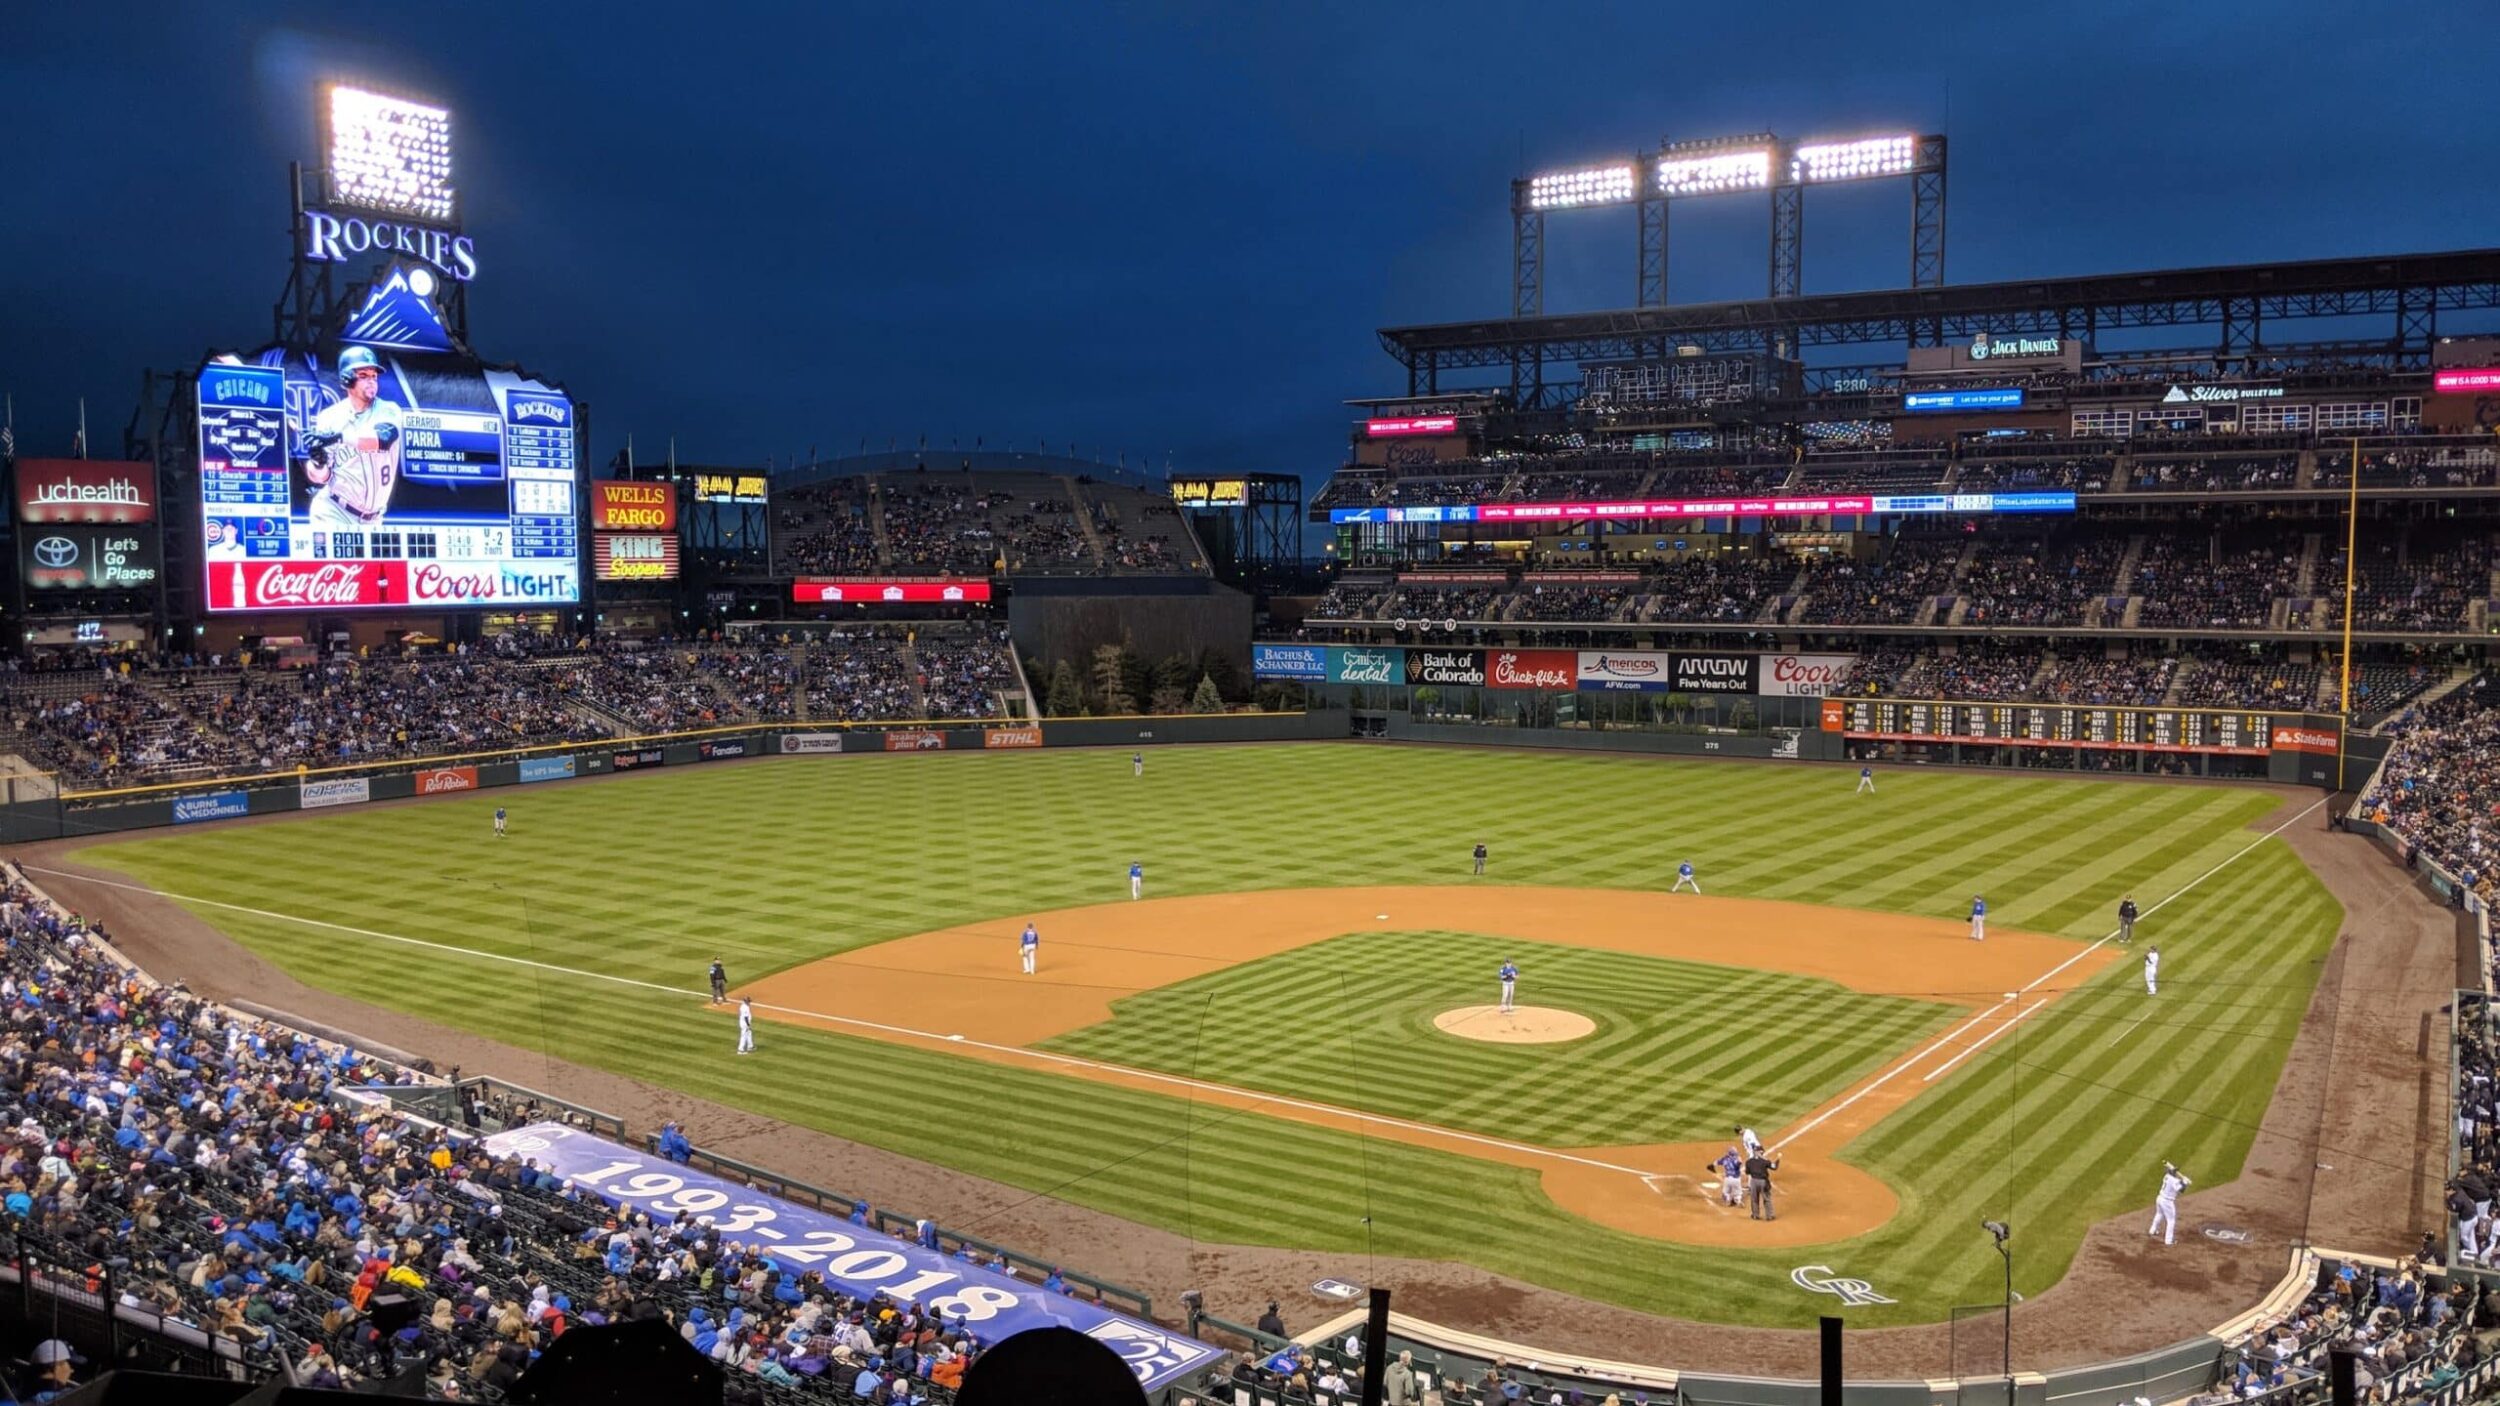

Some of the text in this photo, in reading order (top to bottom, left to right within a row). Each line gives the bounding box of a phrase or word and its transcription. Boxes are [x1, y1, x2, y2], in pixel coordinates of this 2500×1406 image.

[304, 211, 476, 281] ROCKIES
[1991, 337, 2058, 354] JACK DANIEL'S
[216, 379, 269, 404] CHICAGO
[1834, 379, 1867, 392] 5280
[2191, 386, 2239, 400] Silver
[406, 416, 441, 428] GERARDO
[406, 431, 441, 447] PARRA
[406, 450, 423, 460] GAME
[381, 464, 390, 486] 8
[38, 476, 139, 502] uchealth
[604, 487, 665, 503] WELLS
[606, 508, 665, 525] FARGO
[105, 538, 139, 551] Let's
[609, 537, 664, 557] KING
[105, 552, 125, 565] Go
[106, 567, 155, 580] Places
[610, 558, 665, 577] Soopers
[256, 564, 566, 604] Coca-Cola Coors LIGHT
[1264, 649, 1314, 661] BACHUS &
[1344, 650, 1386, 665] Comfort
[1423, 653, 1473, 667] Bank of
[1256, 659, 1324, 671] SCHANKER LLC
[1496, 654, 1568, 687] Chick-fil-A
[1678, 659, 1748, 675] ARROW
[1340, 663, 1392, 682] dental
[1423, 668, 1484, 683] Colorado
[1605, 681, 1641, 689] AFW.com
[1679, 678, 1747, 689] Five Years Out
[1786, 683, 1831, 695] LIGHT
[889, 733, 917, 741] brakes
[991, 733, 1036, 744] STIHL
[712, 746, 743, 756] Fanatics
[522, 768, 533, 777] The
[326, 782, 360, 790] OPTIC
[425, 776, 469, 792] Red Robin
[186, 799, 218, 810] BURNS
[572, 1158, 1019, 1321] 1993-2018
[1791, 1265, 1899, 1306] CR
